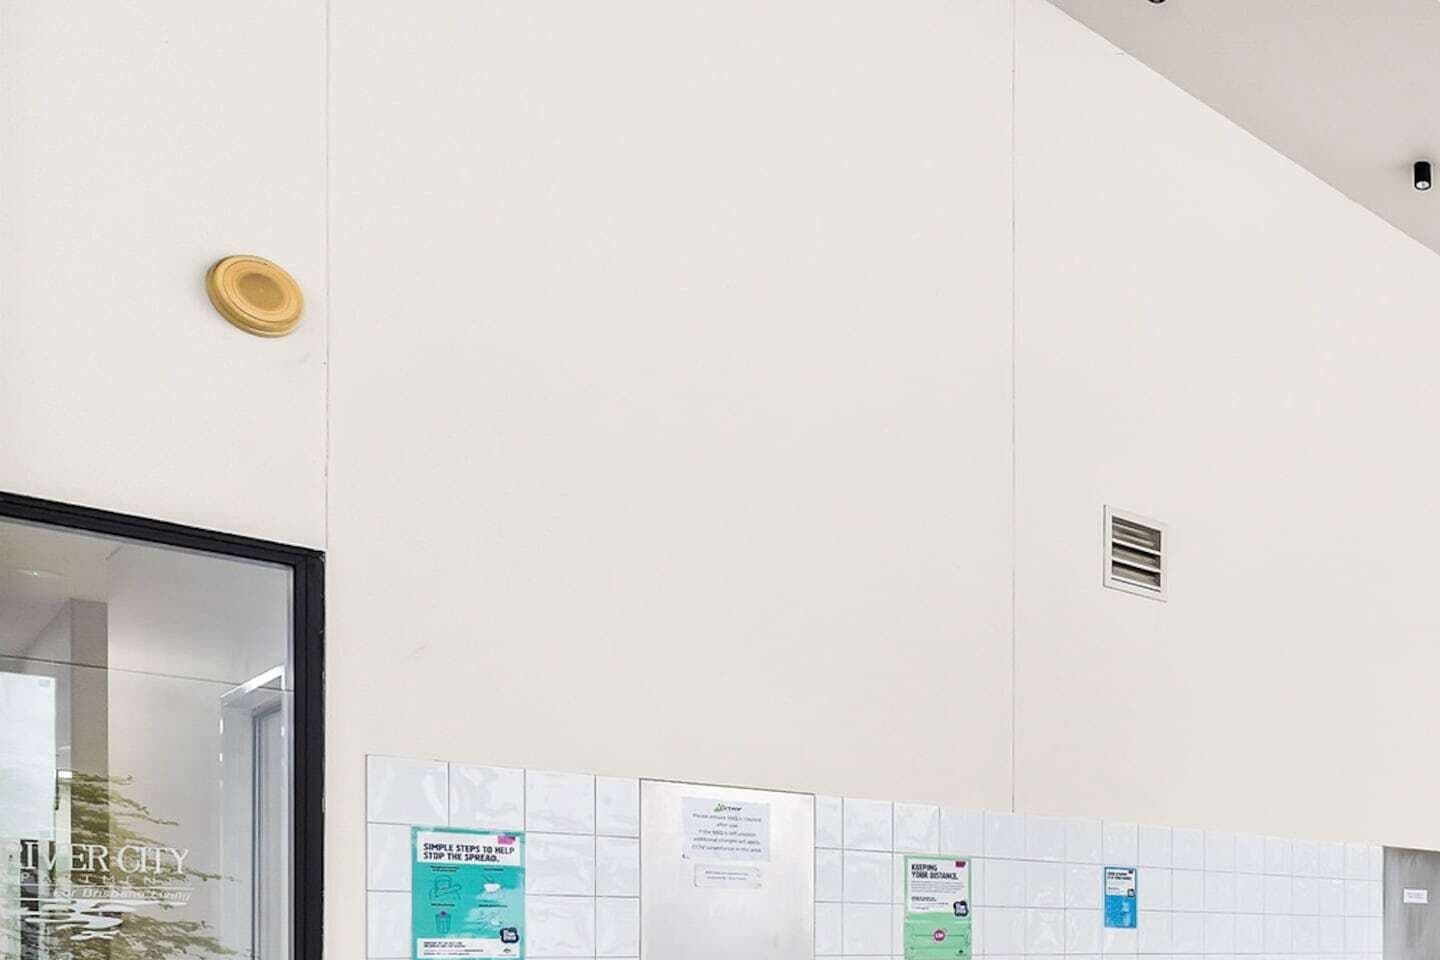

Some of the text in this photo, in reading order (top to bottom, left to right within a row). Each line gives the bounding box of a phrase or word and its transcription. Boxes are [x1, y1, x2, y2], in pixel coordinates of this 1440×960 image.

[424, 843, 515, 855] SIMPLE STEPS TO HELP
[117, 844, 189, 874] CITY
[424, 852, 445, 860] STOP
[447, 853, 463, 861] THE
